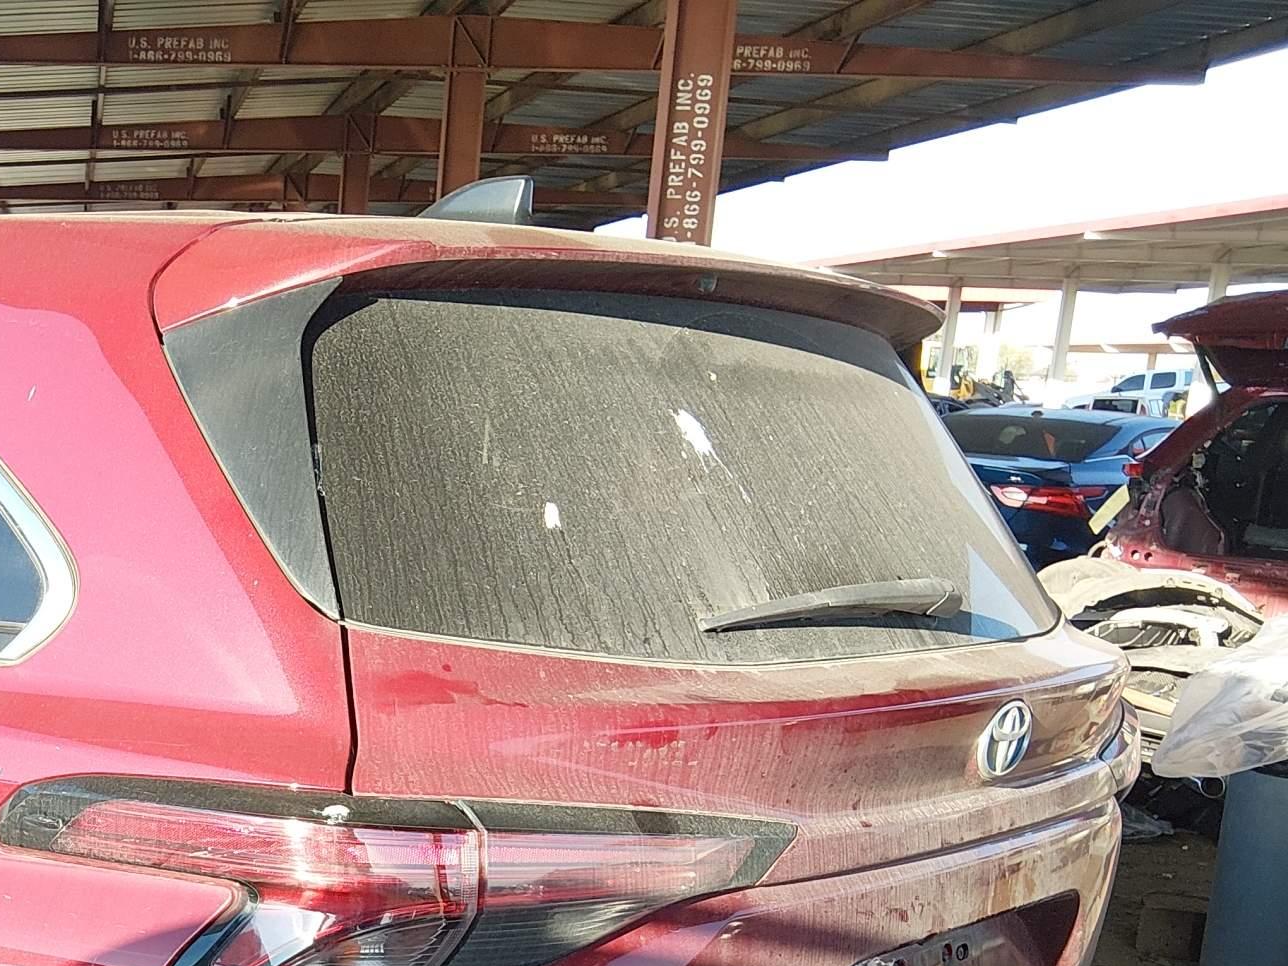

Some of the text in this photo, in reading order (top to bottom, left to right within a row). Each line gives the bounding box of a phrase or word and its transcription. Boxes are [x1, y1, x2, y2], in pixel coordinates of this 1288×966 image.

[127, 36, 152, 49] U.S.
[156, 36, 205, 49] PREFAB
[128, 50, 232, 62] 1-866-799-0969
[736, 45, 812, 59] PREFAB INC.
[675, 73, 695, 111] INC.
[133, 129, 168, 139] PREFAB
[552, 134, 588, 144] PREFAB
[666, 121, 689, 199] PREFAB
